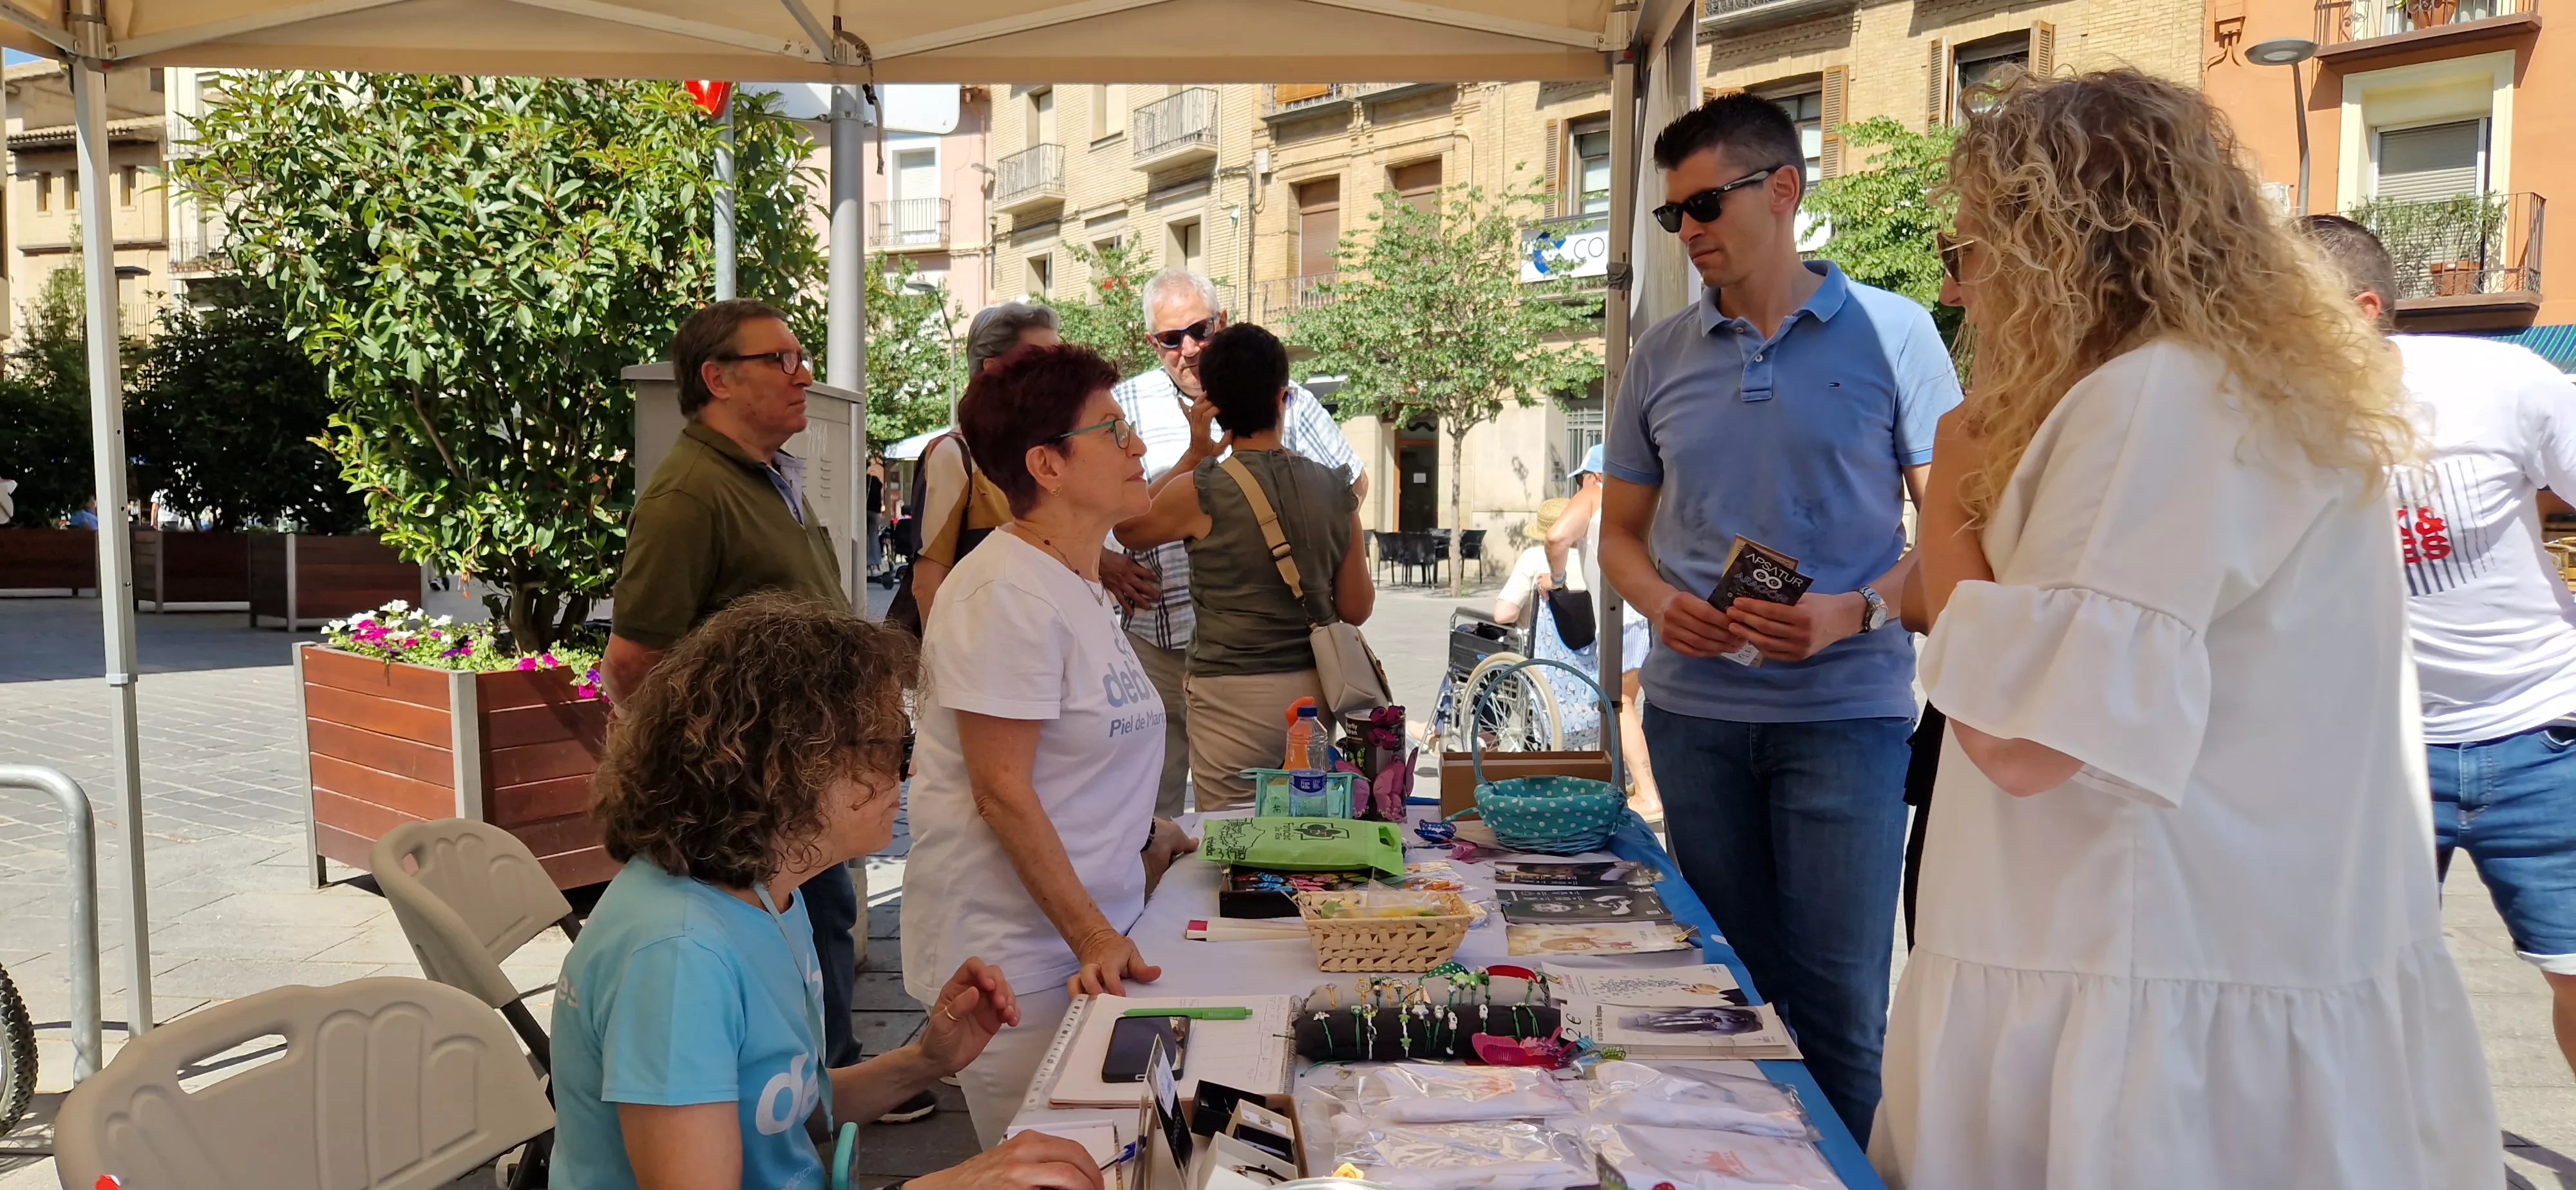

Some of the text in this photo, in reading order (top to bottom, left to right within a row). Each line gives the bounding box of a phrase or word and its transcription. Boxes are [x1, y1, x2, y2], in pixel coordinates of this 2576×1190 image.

[1745, 552, 1804, 588] APSATUR
[1109, 715, 1133, 738] Piel
[1135, 713, 1146, 731] de
